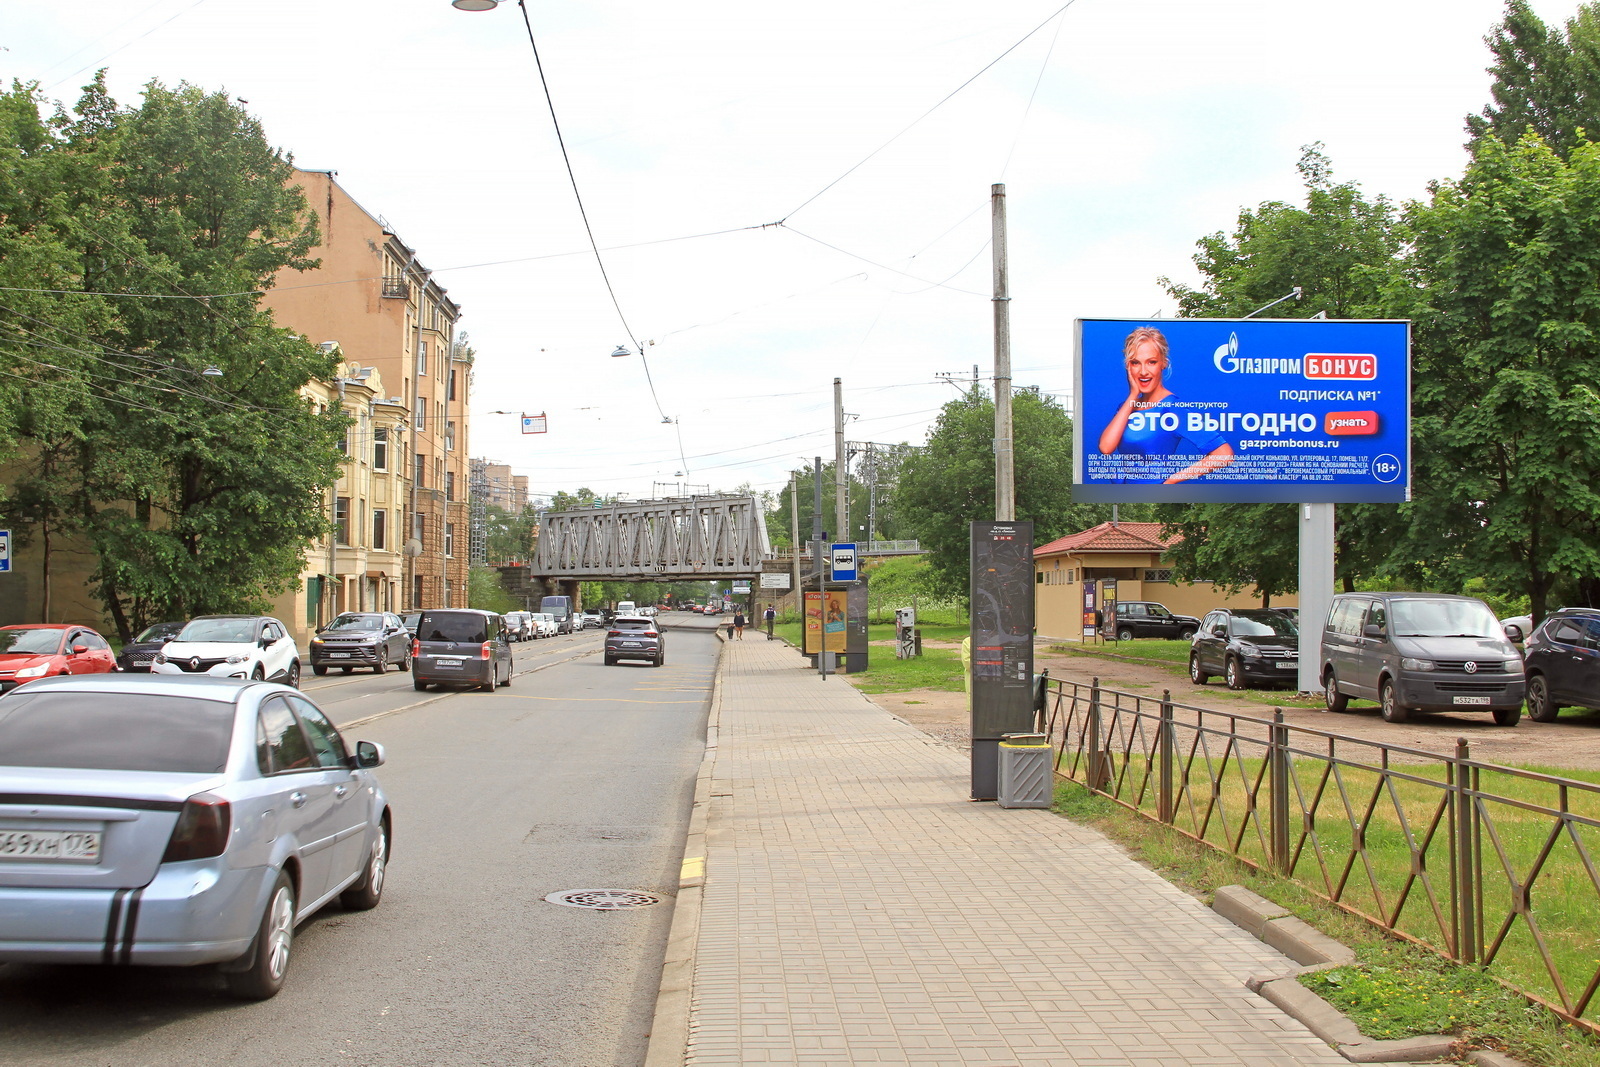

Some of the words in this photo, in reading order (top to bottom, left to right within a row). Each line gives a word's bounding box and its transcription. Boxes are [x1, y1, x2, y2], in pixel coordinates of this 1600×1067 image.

[1239, 358, 1300, 374] ГАЗПРОМ
[1308, 358, 1371, 375] БОНУС
[1279, 390, 1354, 402] ПОДПИСКА
[1129, 400, 1228, 410] Подписка-конструктор
[1128, 412, 1179, 432] ЭТО
[1188, 412, 1316, 435] ВЫГОДНО
[1330, 416, 1368, 430] узнать
[1239, 438, 1340, 450] gazprombonus.ru
[1376, 462, 1397, 474] 18+
